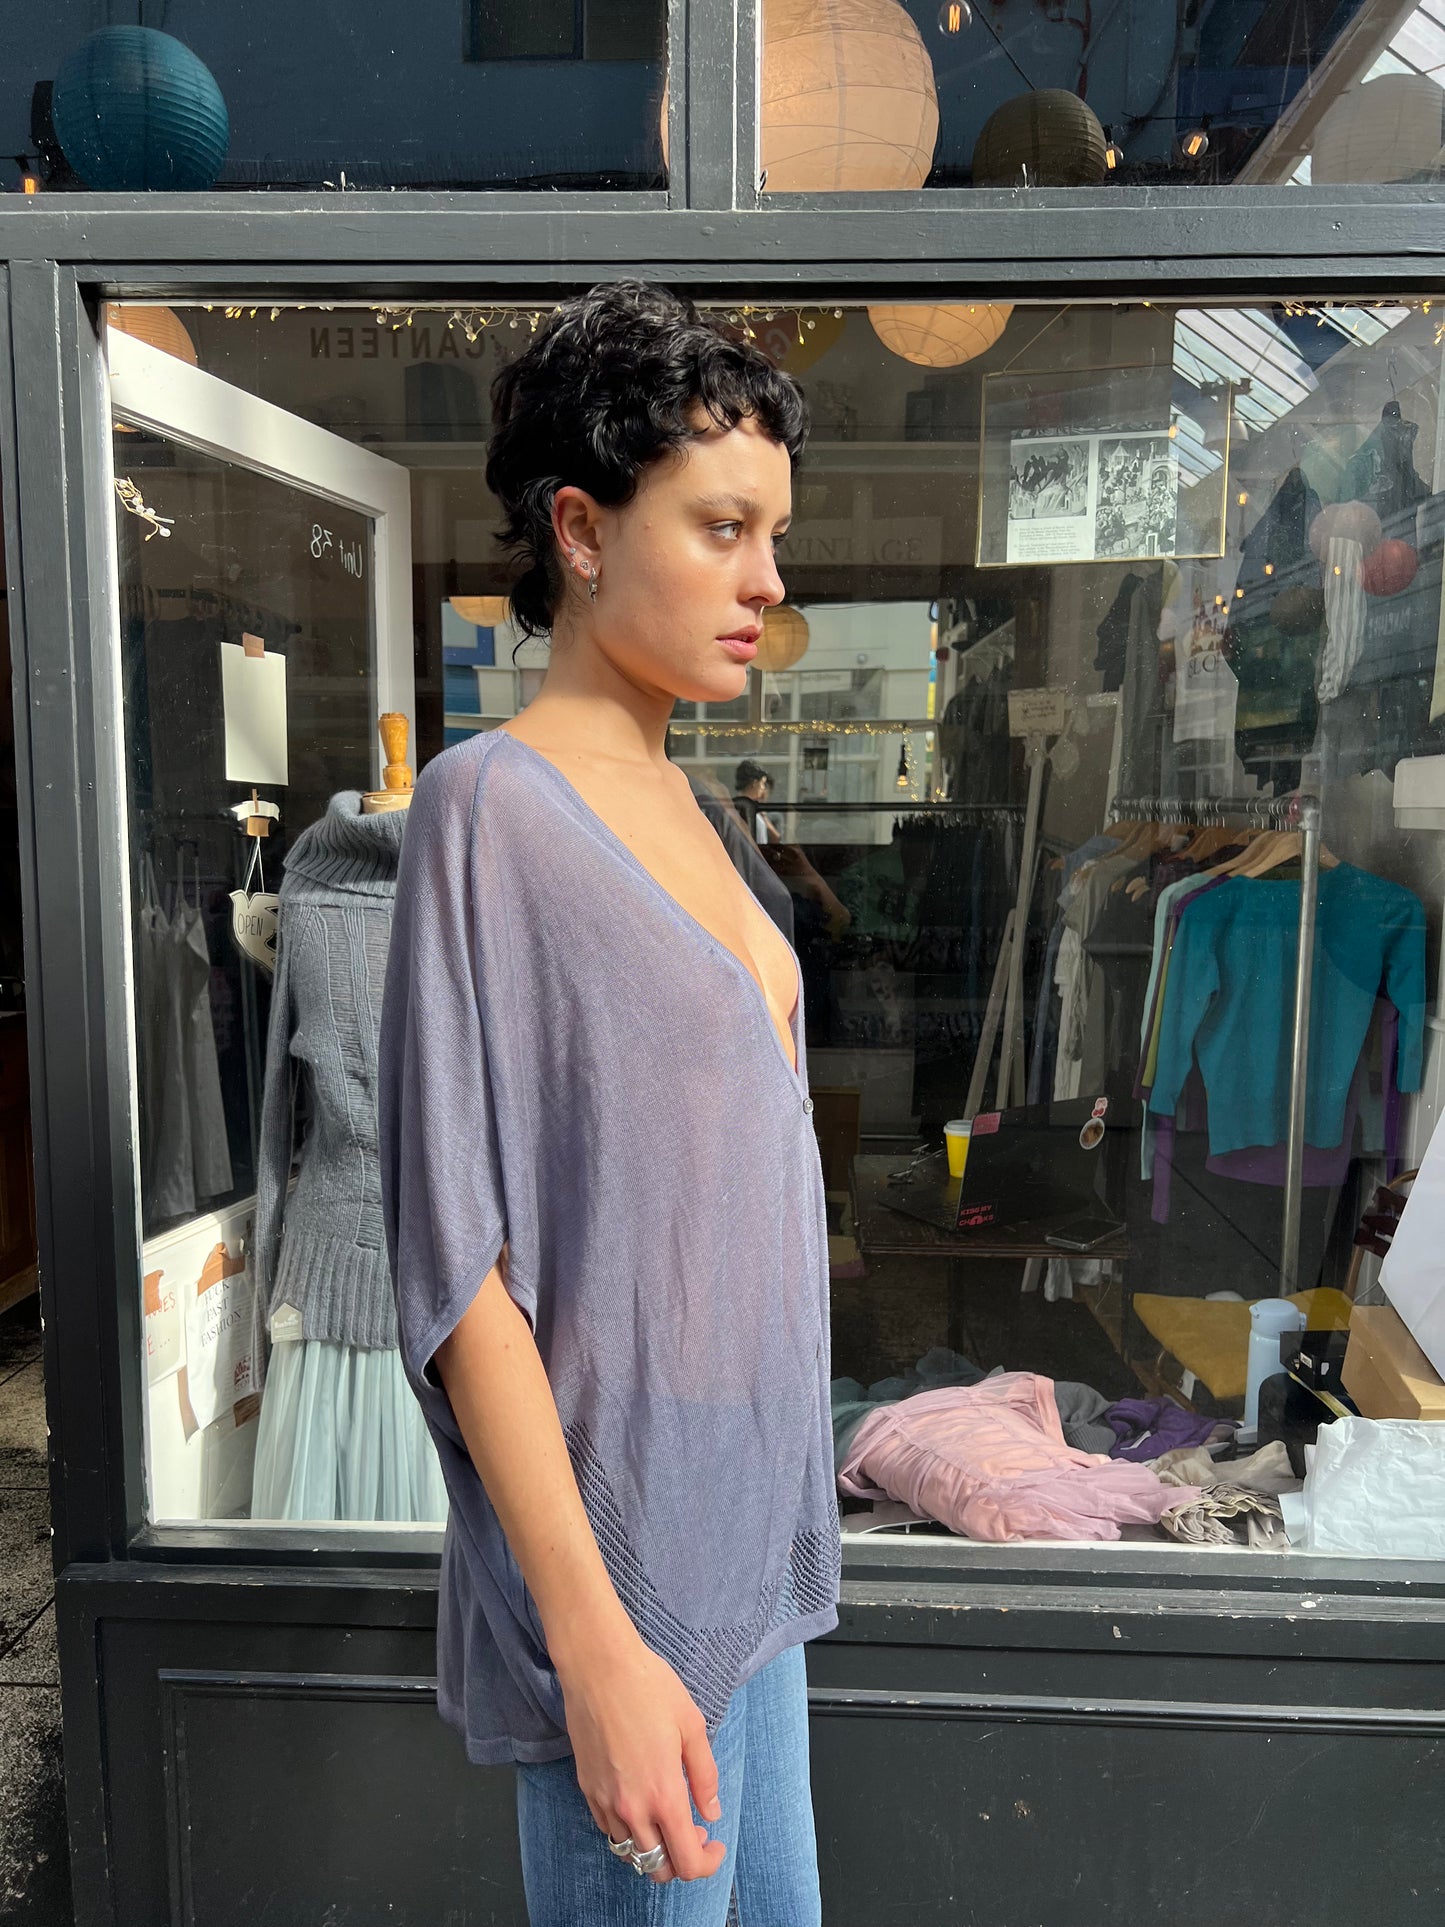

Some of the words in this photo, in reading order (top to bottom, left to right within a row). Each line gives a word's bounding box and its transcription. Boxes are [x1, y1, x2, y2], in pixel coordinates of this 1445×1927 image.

[237, 913, 264, 937] OPEN
[206, 1297, 229, 1322] FAST
[200, 1311, 242, 1348] FASHION
